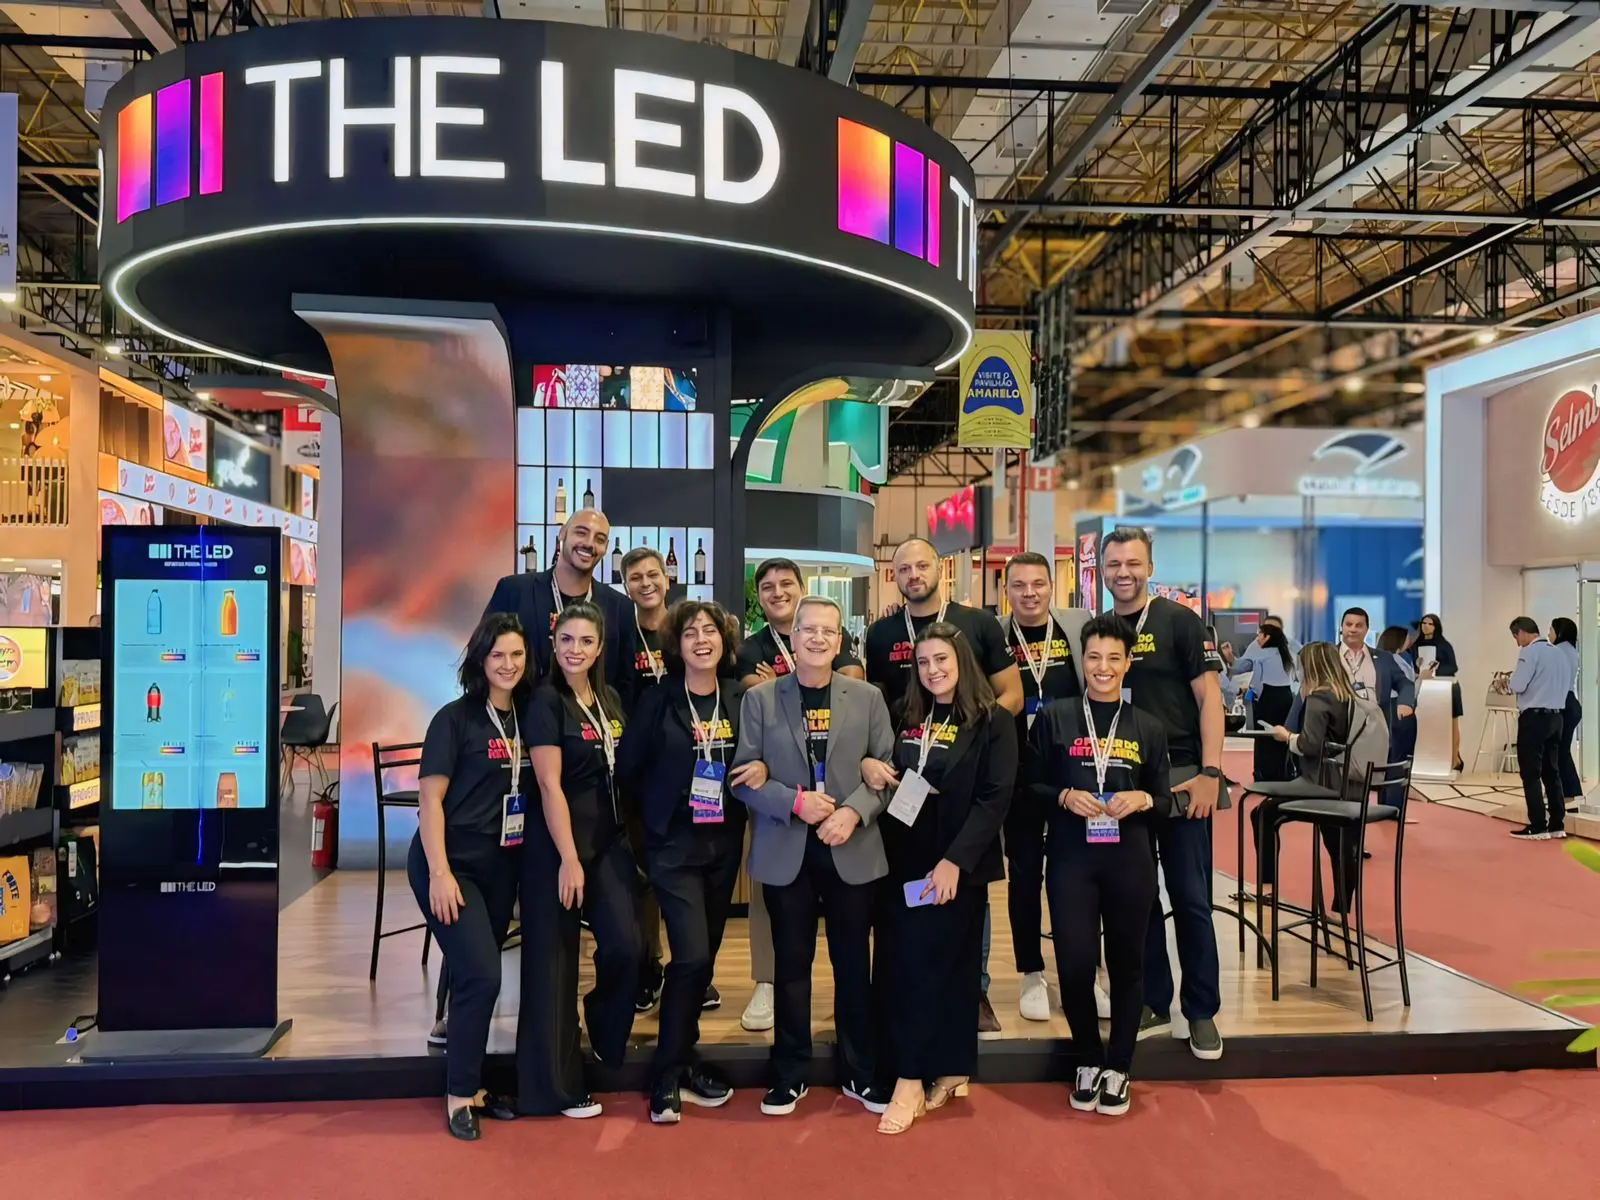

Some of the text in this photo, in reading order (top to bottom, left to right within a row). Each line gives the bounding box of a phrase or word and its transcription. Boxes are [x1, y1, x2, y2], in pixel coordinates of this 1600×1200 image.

[245, 55, 782, 204] THE LED
[950, 175, 977, 309] TH
[977, 371, 1001, 379] VISITE
[967, 388, 1020, 399] AMARELO
[173, 543, 234, 559] THE LED
[1051, 639, 1067, 649] DO
[1124, 740, 1139, 751] DO
